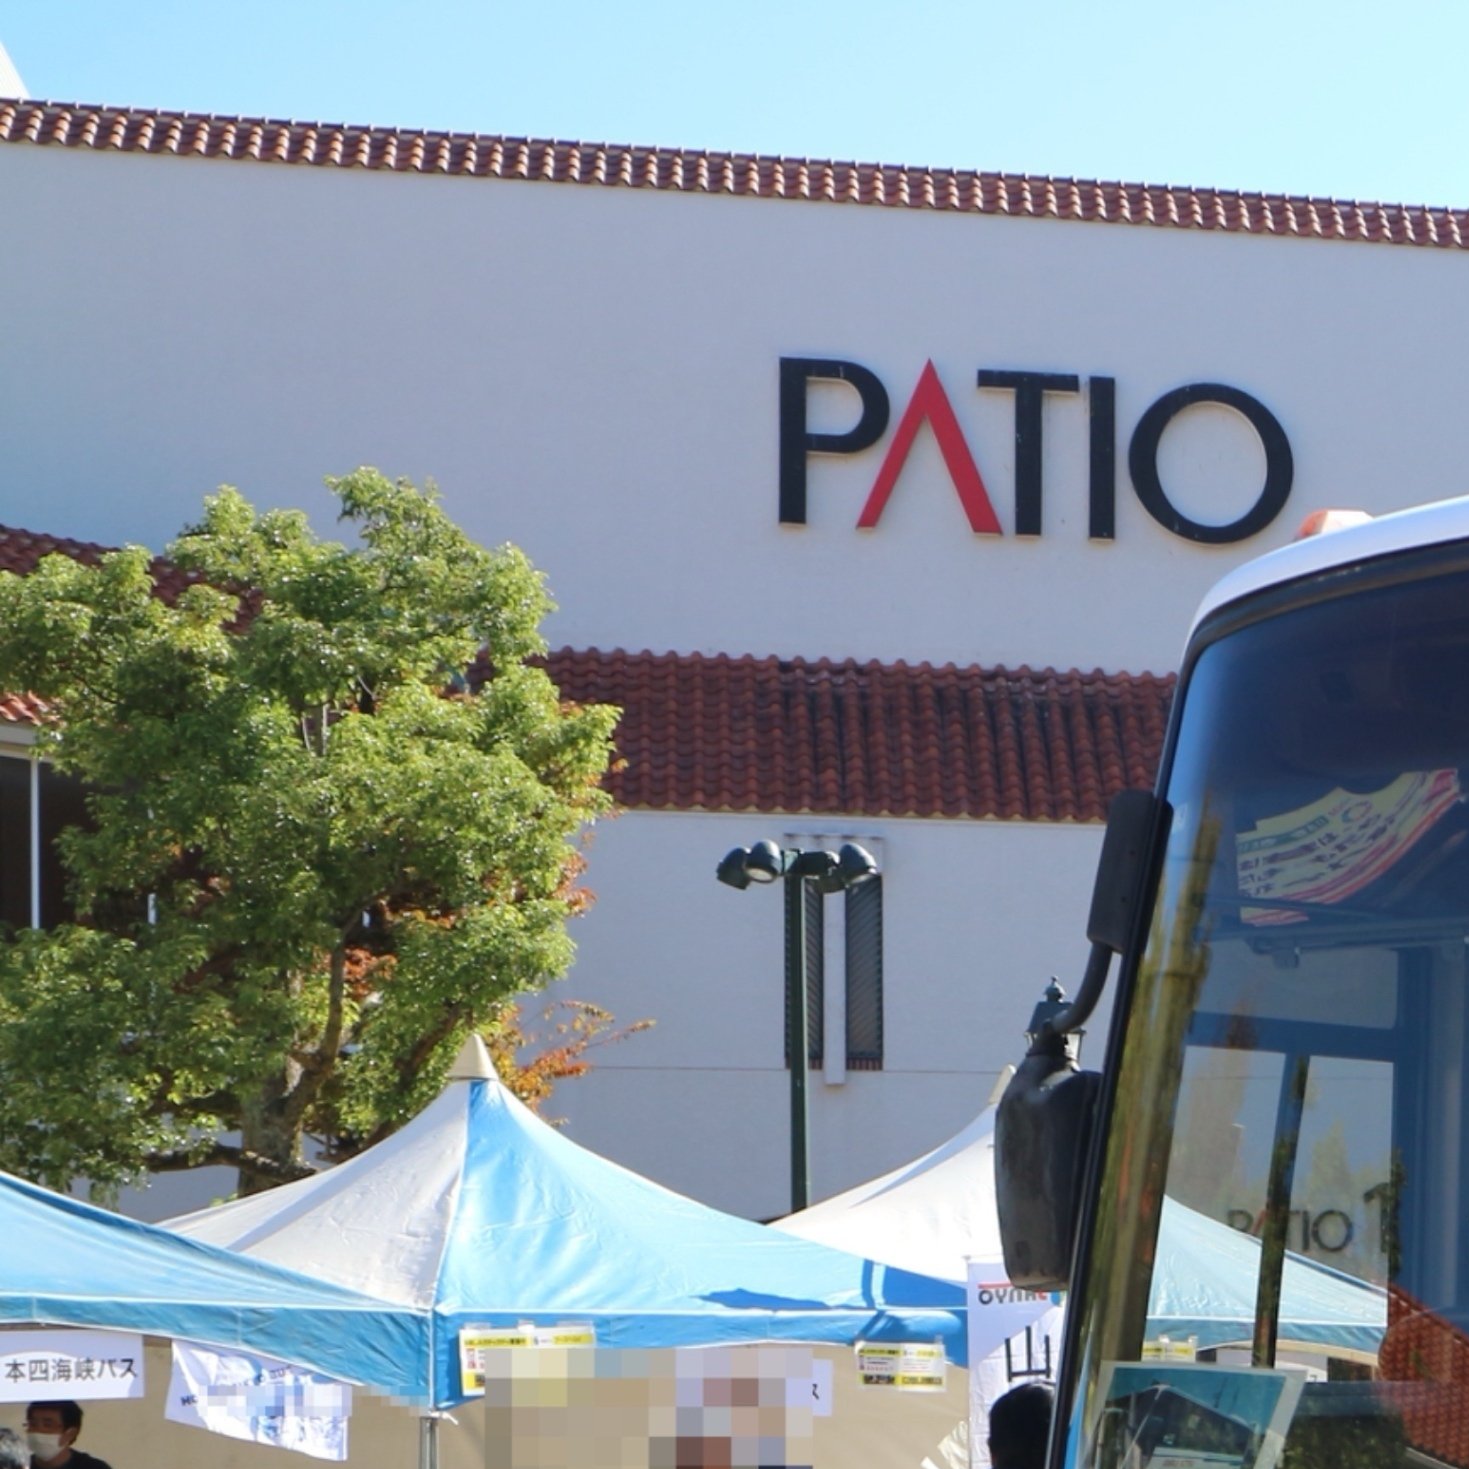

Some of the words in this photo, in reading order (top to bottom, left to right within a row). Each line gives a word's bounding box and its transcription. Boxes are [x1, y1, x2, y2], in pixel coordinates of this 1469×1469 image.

[779, 356, 1294, 545] PATIO
[4, 1358, 138, 1384] 本四海峡バス
